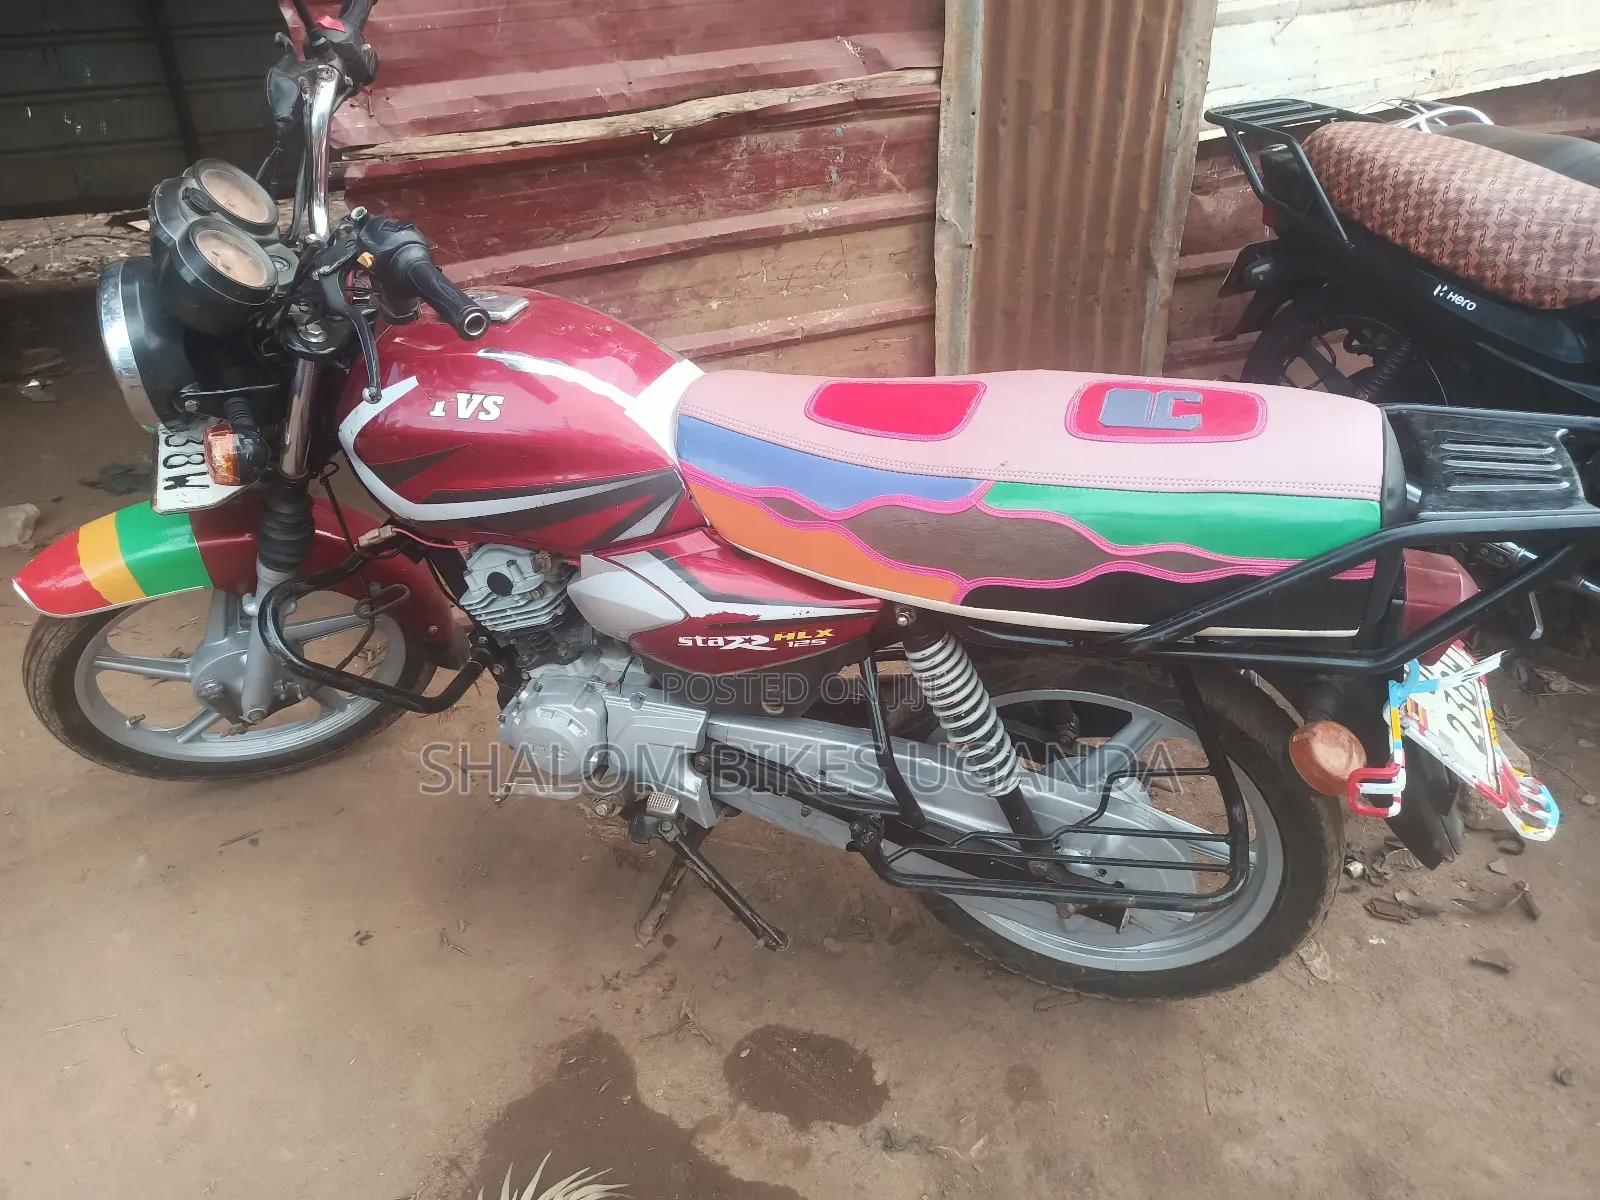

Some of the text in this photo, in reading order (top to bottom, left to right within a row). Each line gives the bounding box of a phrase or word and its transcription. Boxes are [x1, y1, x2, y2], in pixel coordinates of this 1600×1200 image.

[1446, 291, 1477, 311] Hero
[773, 628, 836, 642] HLX
[786, 638, 828, 648] 125
